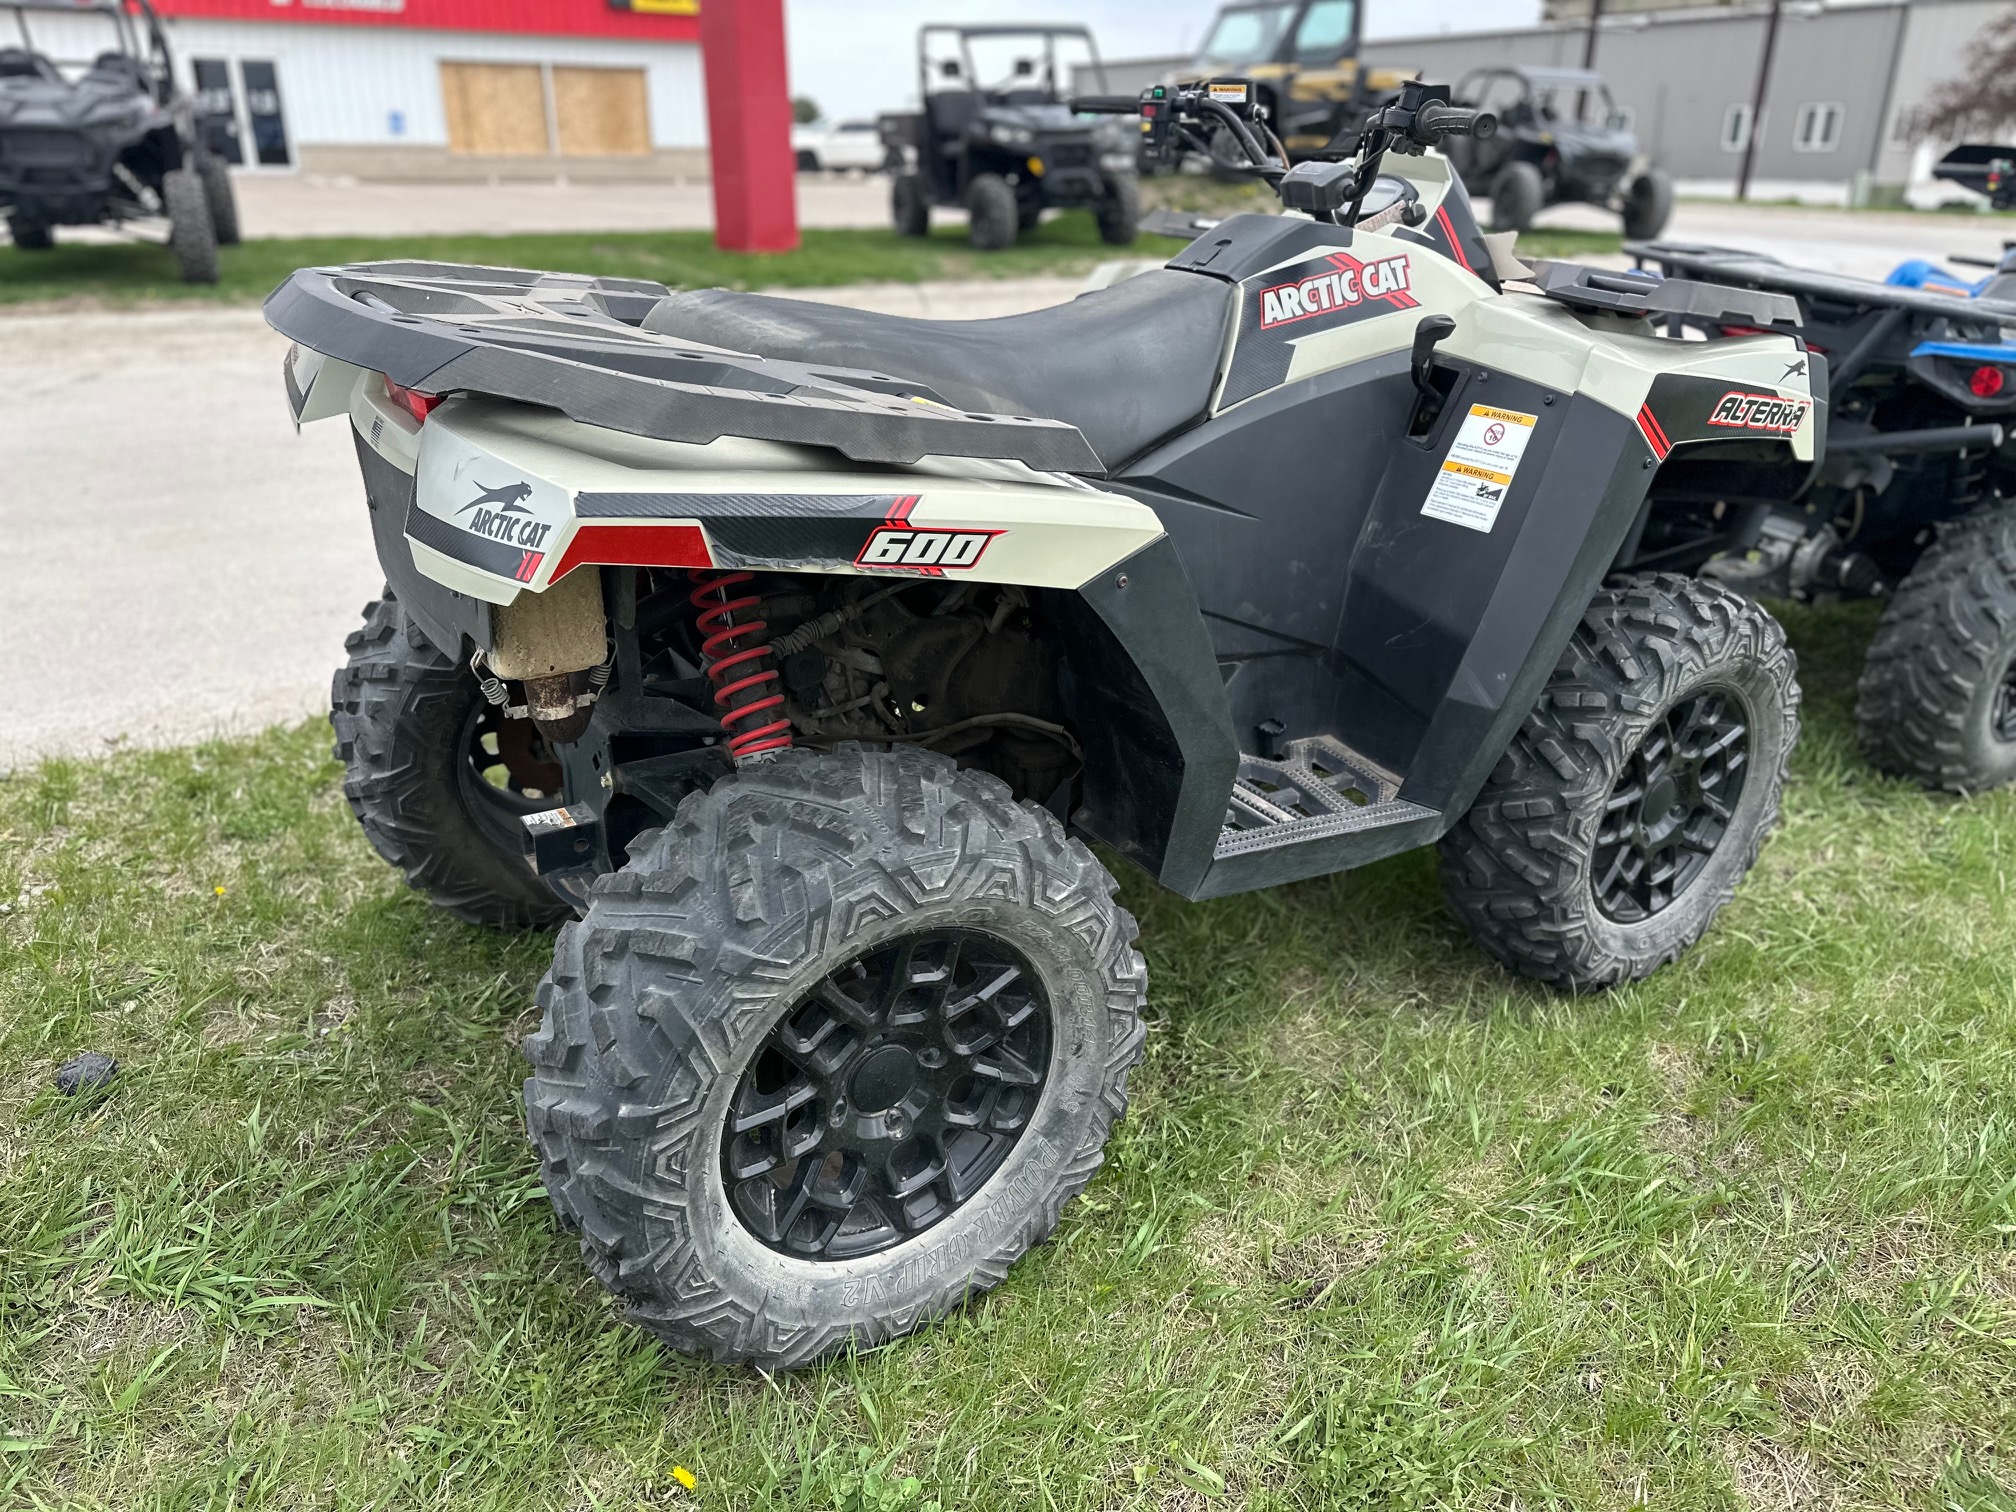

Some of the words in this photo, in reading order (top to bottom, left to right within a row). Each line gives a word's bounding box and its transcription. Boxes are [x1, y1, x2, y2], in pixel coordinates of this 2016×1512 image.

[1263, 269, 1360, 325] ARCTIC
[1361, 257, 1408, 297] CAT
[1490, 410, 1523, 423] WARNING
[1713, 396, 1806, 428] ALTERRA
[1463, 466, 1495, 480] WARNING
[469, 507, 516, 543] ARCTIC
[517, 522, 552, 549] CAT
[861, 531, 989, 566] 600
[973, 1137, 1060, 1245] POWER
[896, 1230, 969, 1295] GRIP
[842, 1274, 888, 1308] V2
